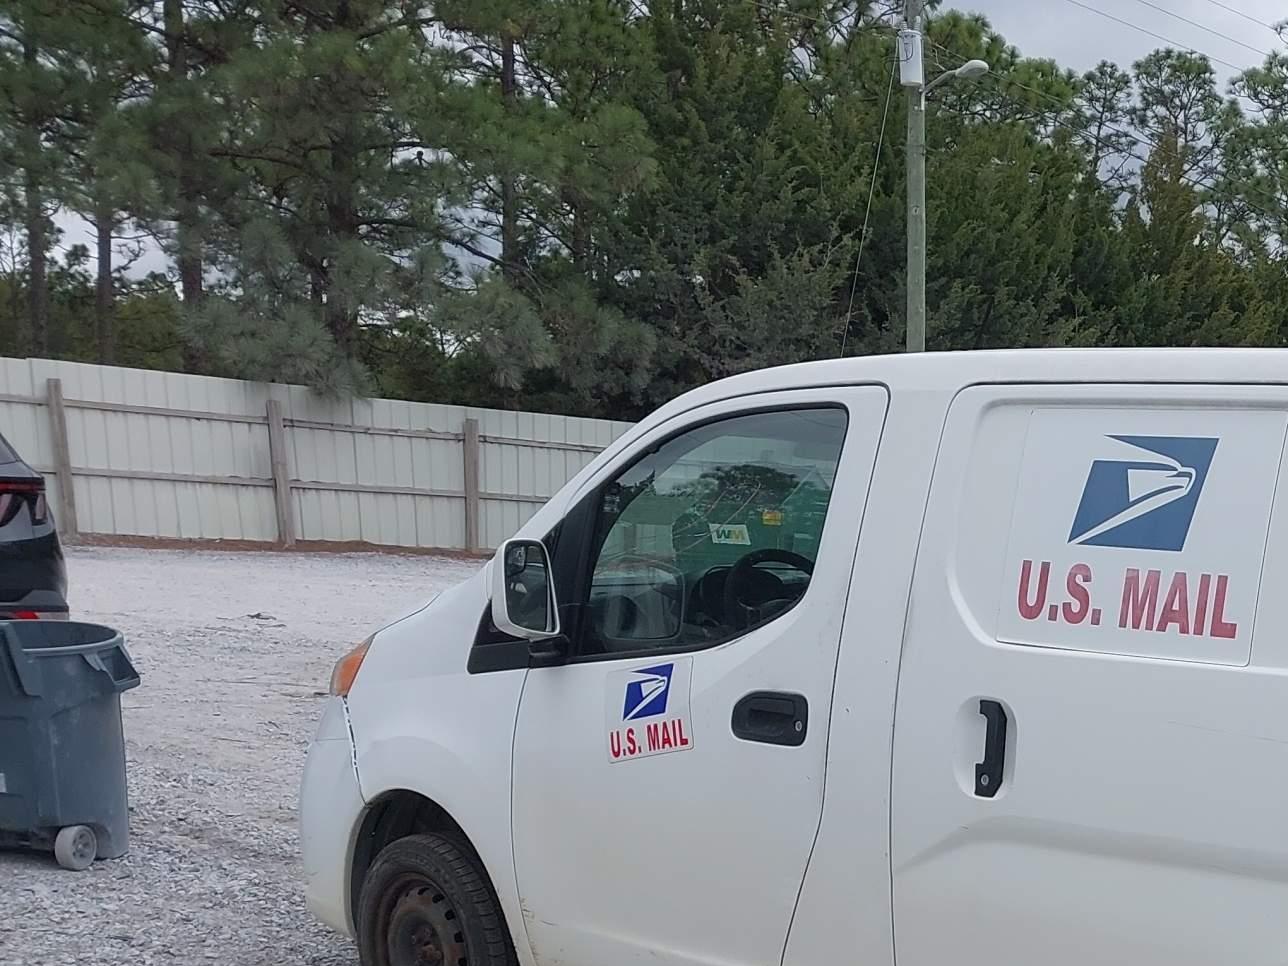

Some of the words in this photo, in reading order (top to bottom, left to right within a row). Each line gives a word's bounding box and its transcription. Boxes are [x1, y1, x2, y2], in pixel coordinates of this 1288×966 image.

[1017, 559, 1102, 626] U.S.
[1118, 567, 1238, 639] MAIL
[610, 727, 642, 758] U.S.
[646, 718, 689, 752] MAIL
